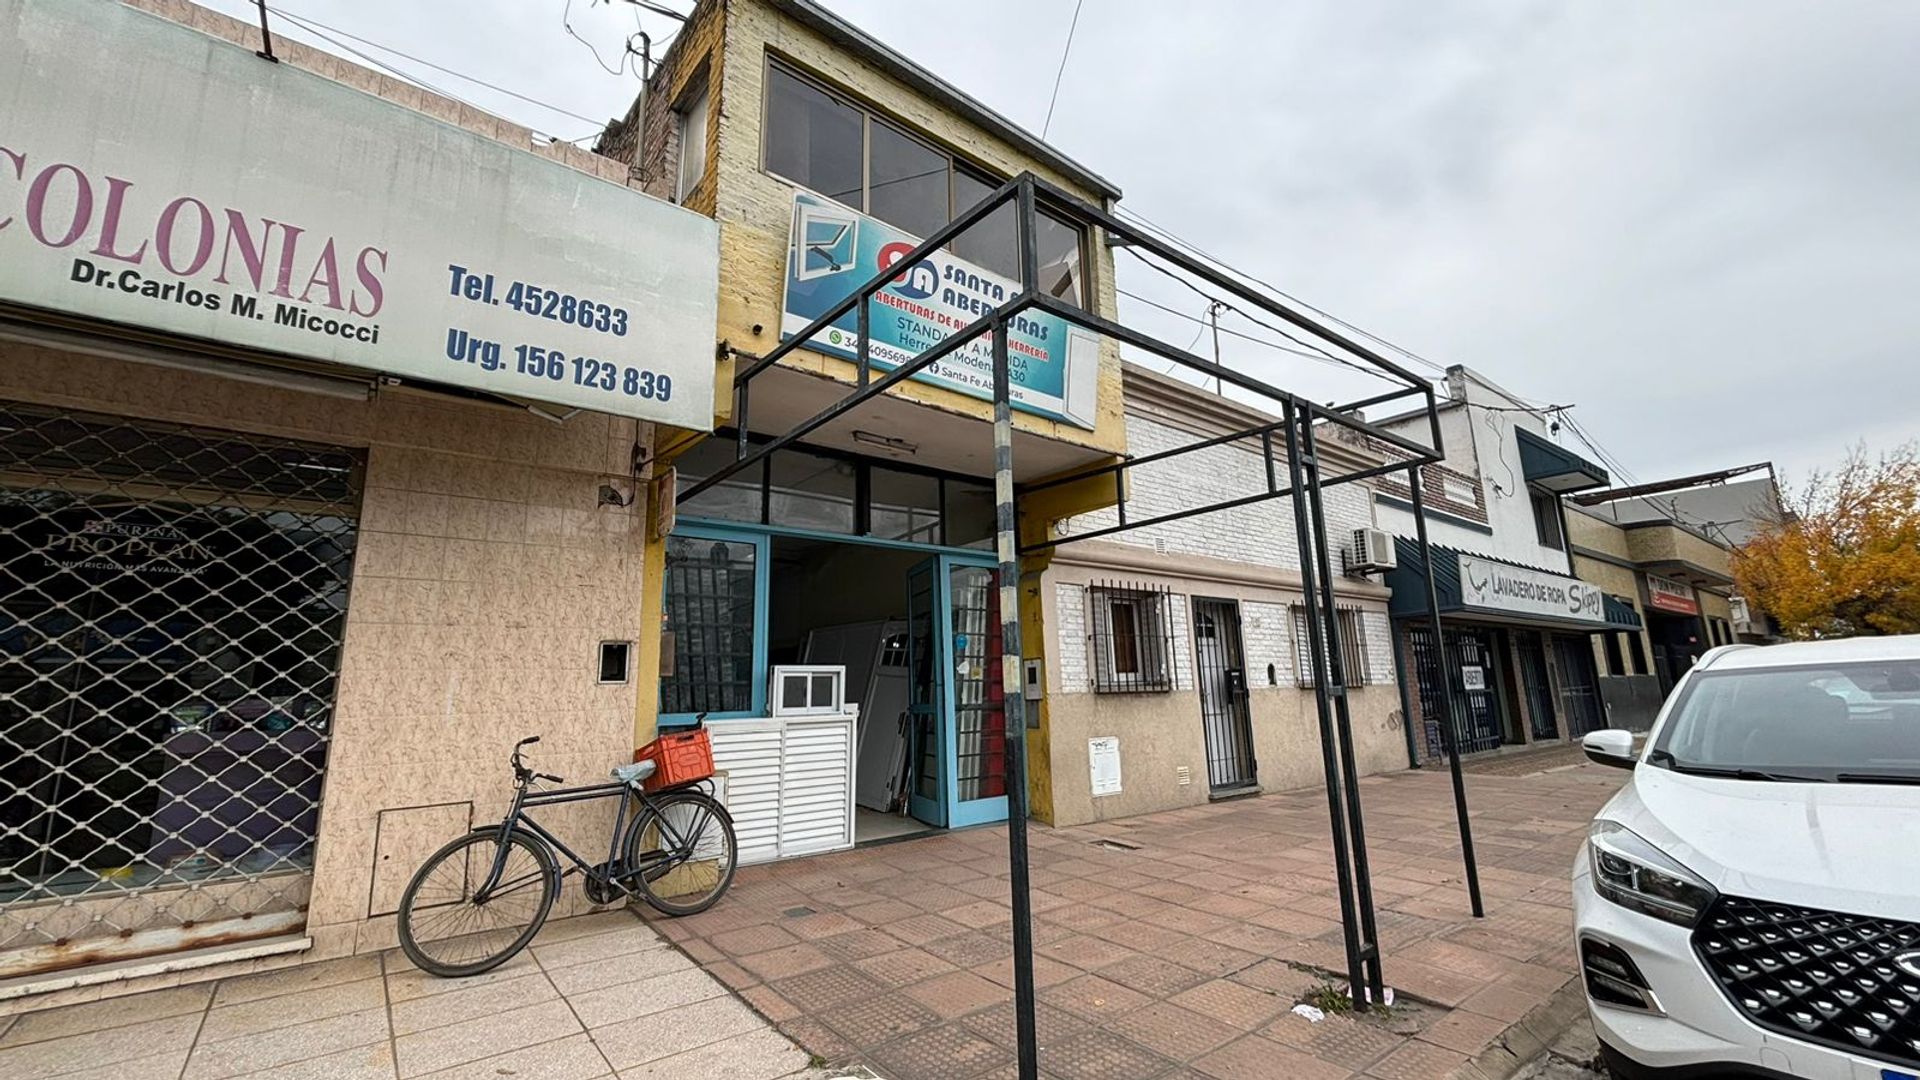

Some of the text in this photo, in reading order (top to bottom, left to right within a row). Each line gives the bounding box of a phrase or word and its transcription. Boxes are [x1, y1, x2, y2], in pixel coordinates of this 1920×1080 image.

[448, 264, 629, 337] Tel. 4528633
[943, 264, 1004, 303] SANTA
[70, 258, 380, 344] Dr.Carlos M. Micocci
[875, 290, 952, 327] ABERTURAS DE
[445, 328, 673, 402] Urg. 156 123 839
[941, 366, 968, 382] Santa
[969, 375, 981, 387] Fe
[953, 350, 996, 374] Moden
[46, 533, 210, 561] PRO PLAN
[105, 523, 178, 539] PURINA
[1491, 571, 1536, 601] LAVADERO
[1536, 584, 1547, 602] DE
